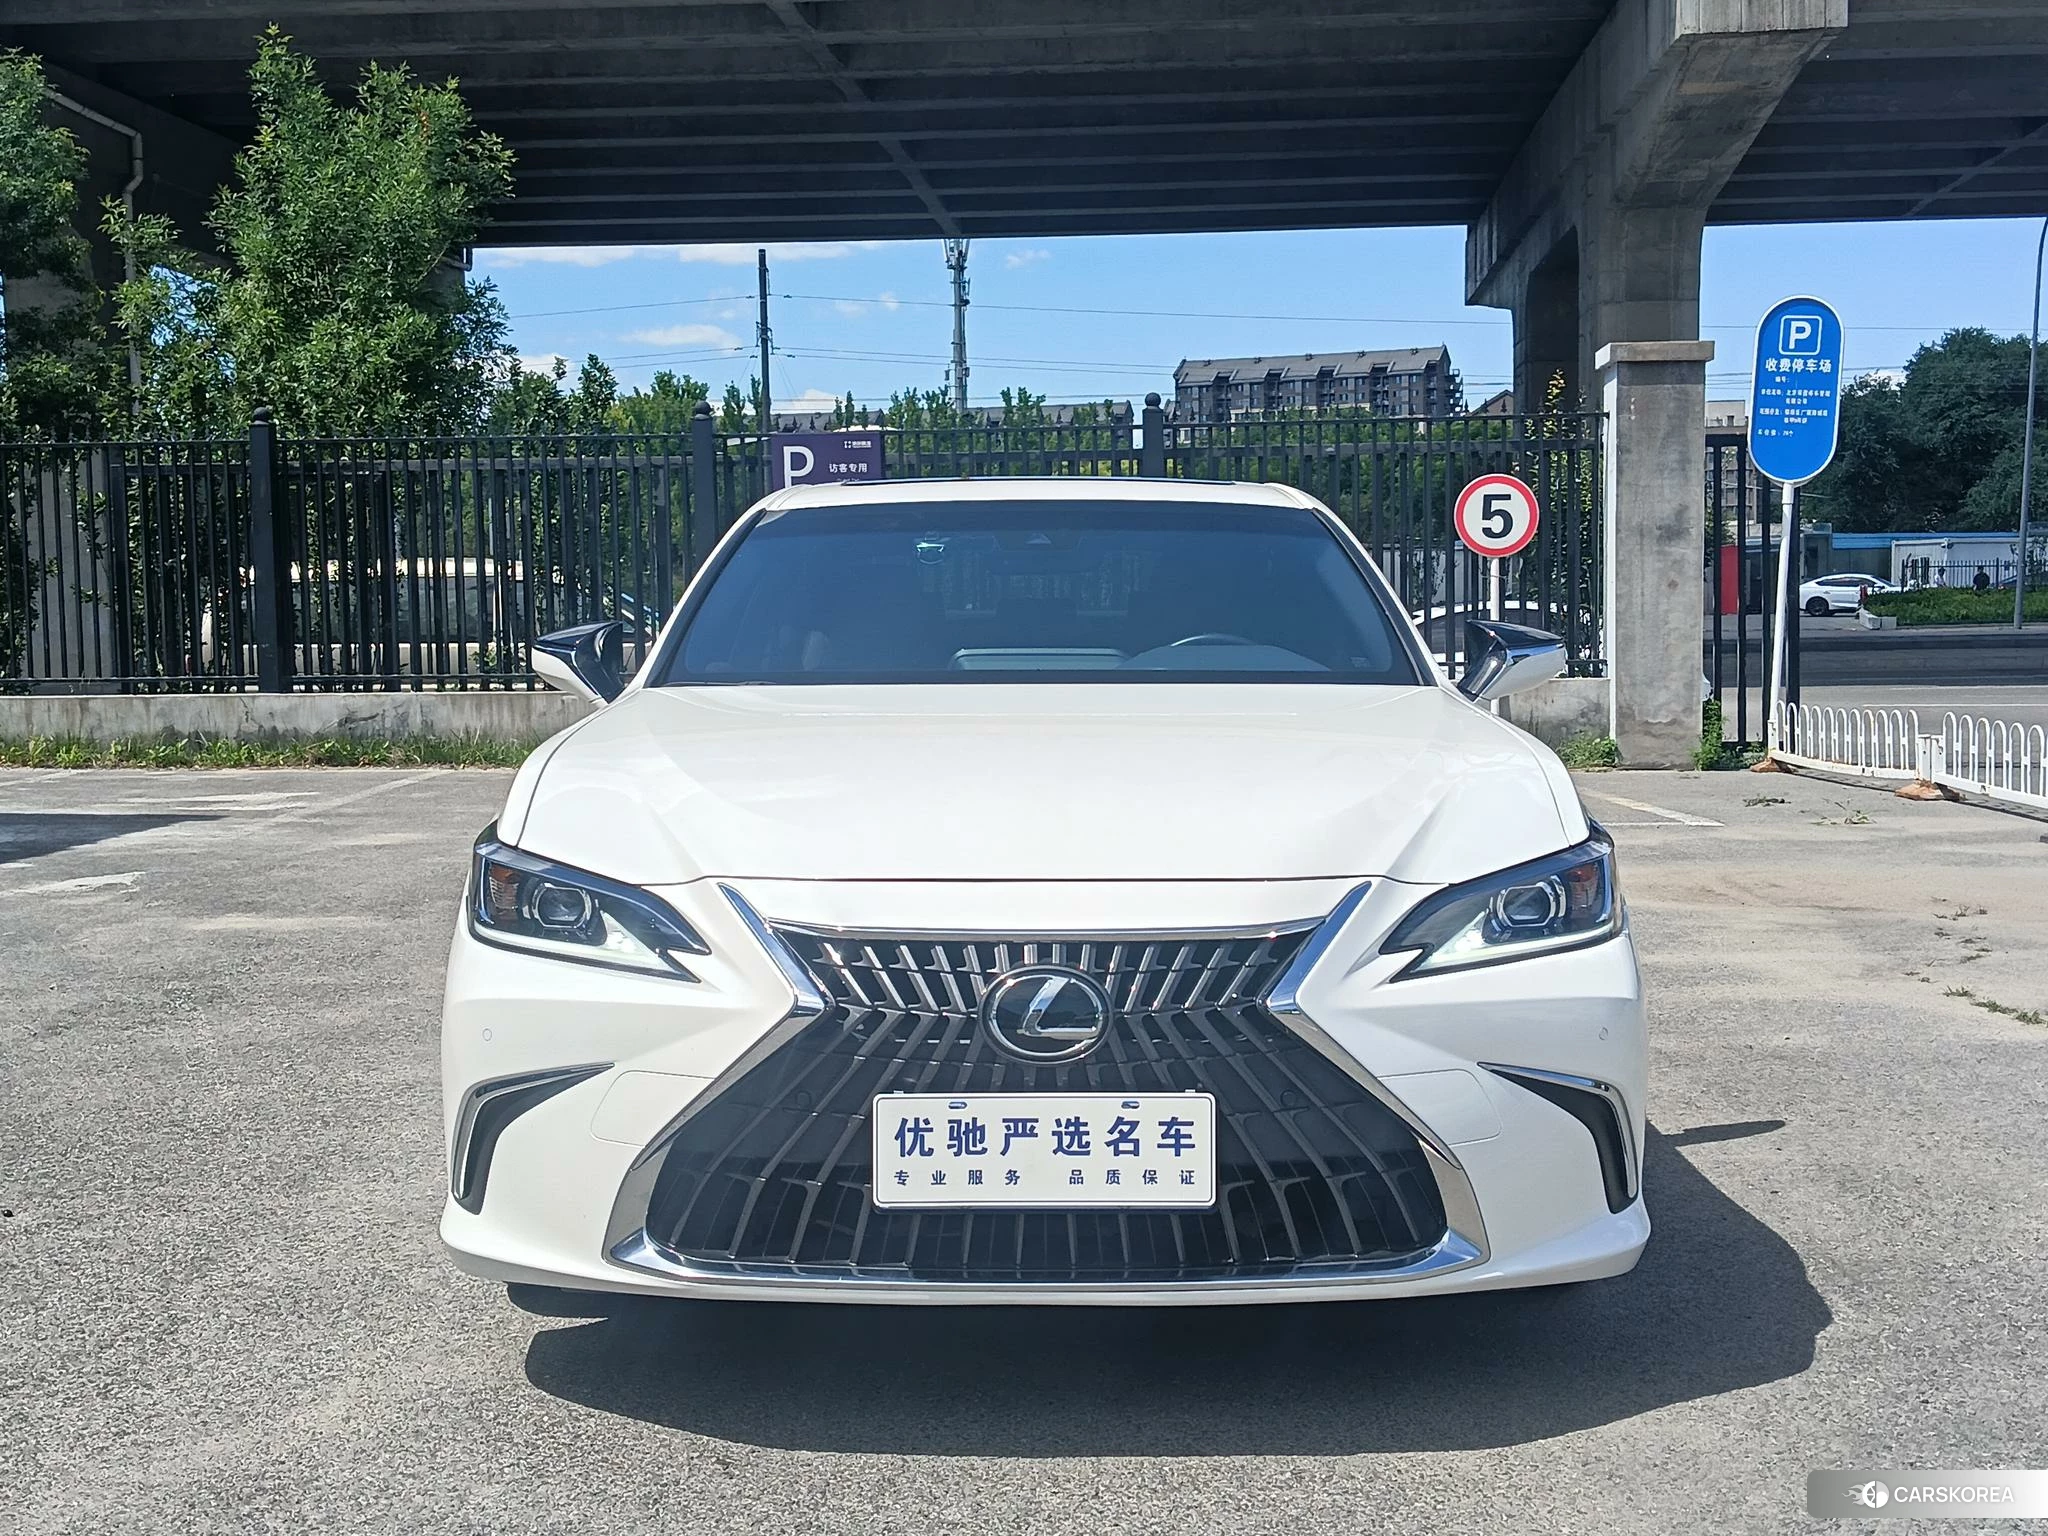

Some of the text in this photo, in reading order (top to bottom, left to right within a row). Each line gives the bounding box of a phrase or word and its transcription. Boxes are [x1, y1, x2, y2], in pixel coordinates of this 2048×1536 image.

[1788, 320, 1812, 349] P
[1765, 357, 1832, 373] 收费停车场
[783, 445, 815, 489] P
[829, 463, 868, 473] 访客专用
[1481, 494, 1513, 539] 5
[894, 1116, 1196, 1158] 优驰严选名车
[894, 1169, 1196, 1186] 专业服务 品质保证
